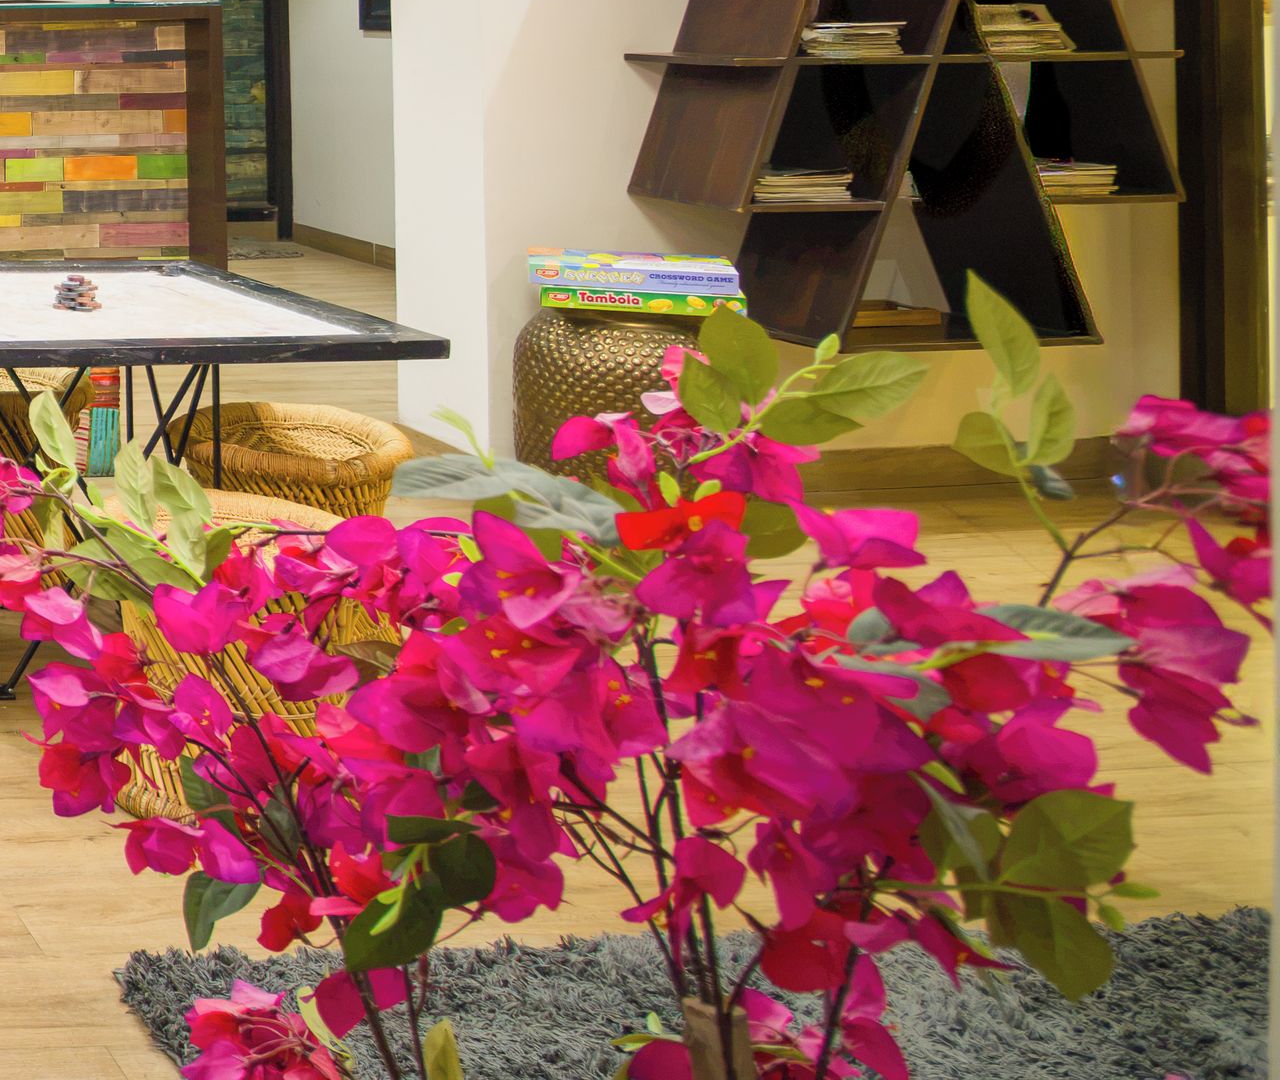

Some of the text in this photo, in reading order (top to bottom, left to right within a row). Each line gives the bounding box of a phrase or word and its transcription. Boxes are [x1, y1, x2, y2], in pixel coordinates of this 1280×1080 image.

[649, 273, 734, 284] CROSSWORD GAME
[578, 292, 640, 306] Tambola
